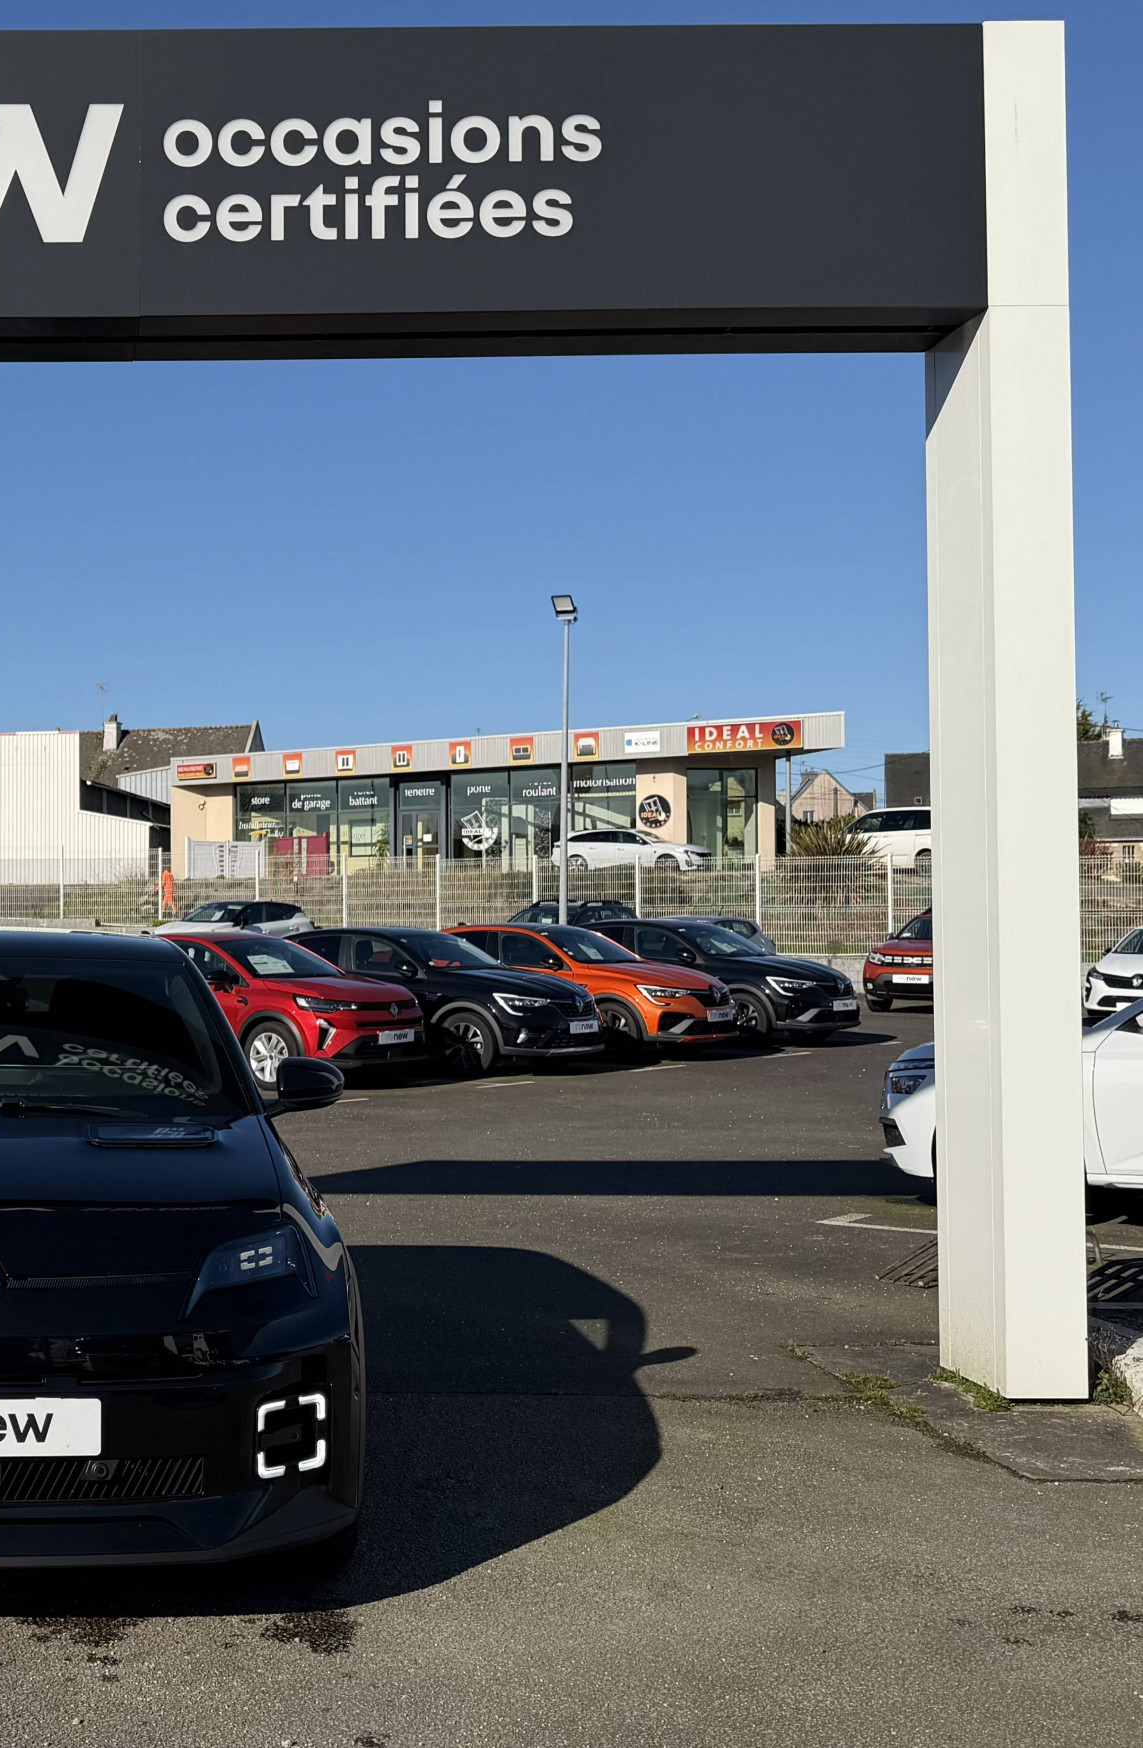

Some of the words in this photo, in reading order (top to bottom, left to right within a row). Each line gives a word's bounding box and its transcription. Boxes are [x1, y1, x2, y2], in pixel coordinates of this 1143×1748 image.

[162, 99, 603, 168] occasions
[162, 173, 574, 243] certifiées
[694, 723, 764, 742] IDEAL
[694, 739, 764, 751] CONFORT
[573, 777, 636, 788] motorisation
[522, 785, 557, 797] roulant
[251, 796, 270, 805] store
[291, 798, 303, 809] de
[304, 798, 331, 811] garage
[349, 795, 378, 807] battant
